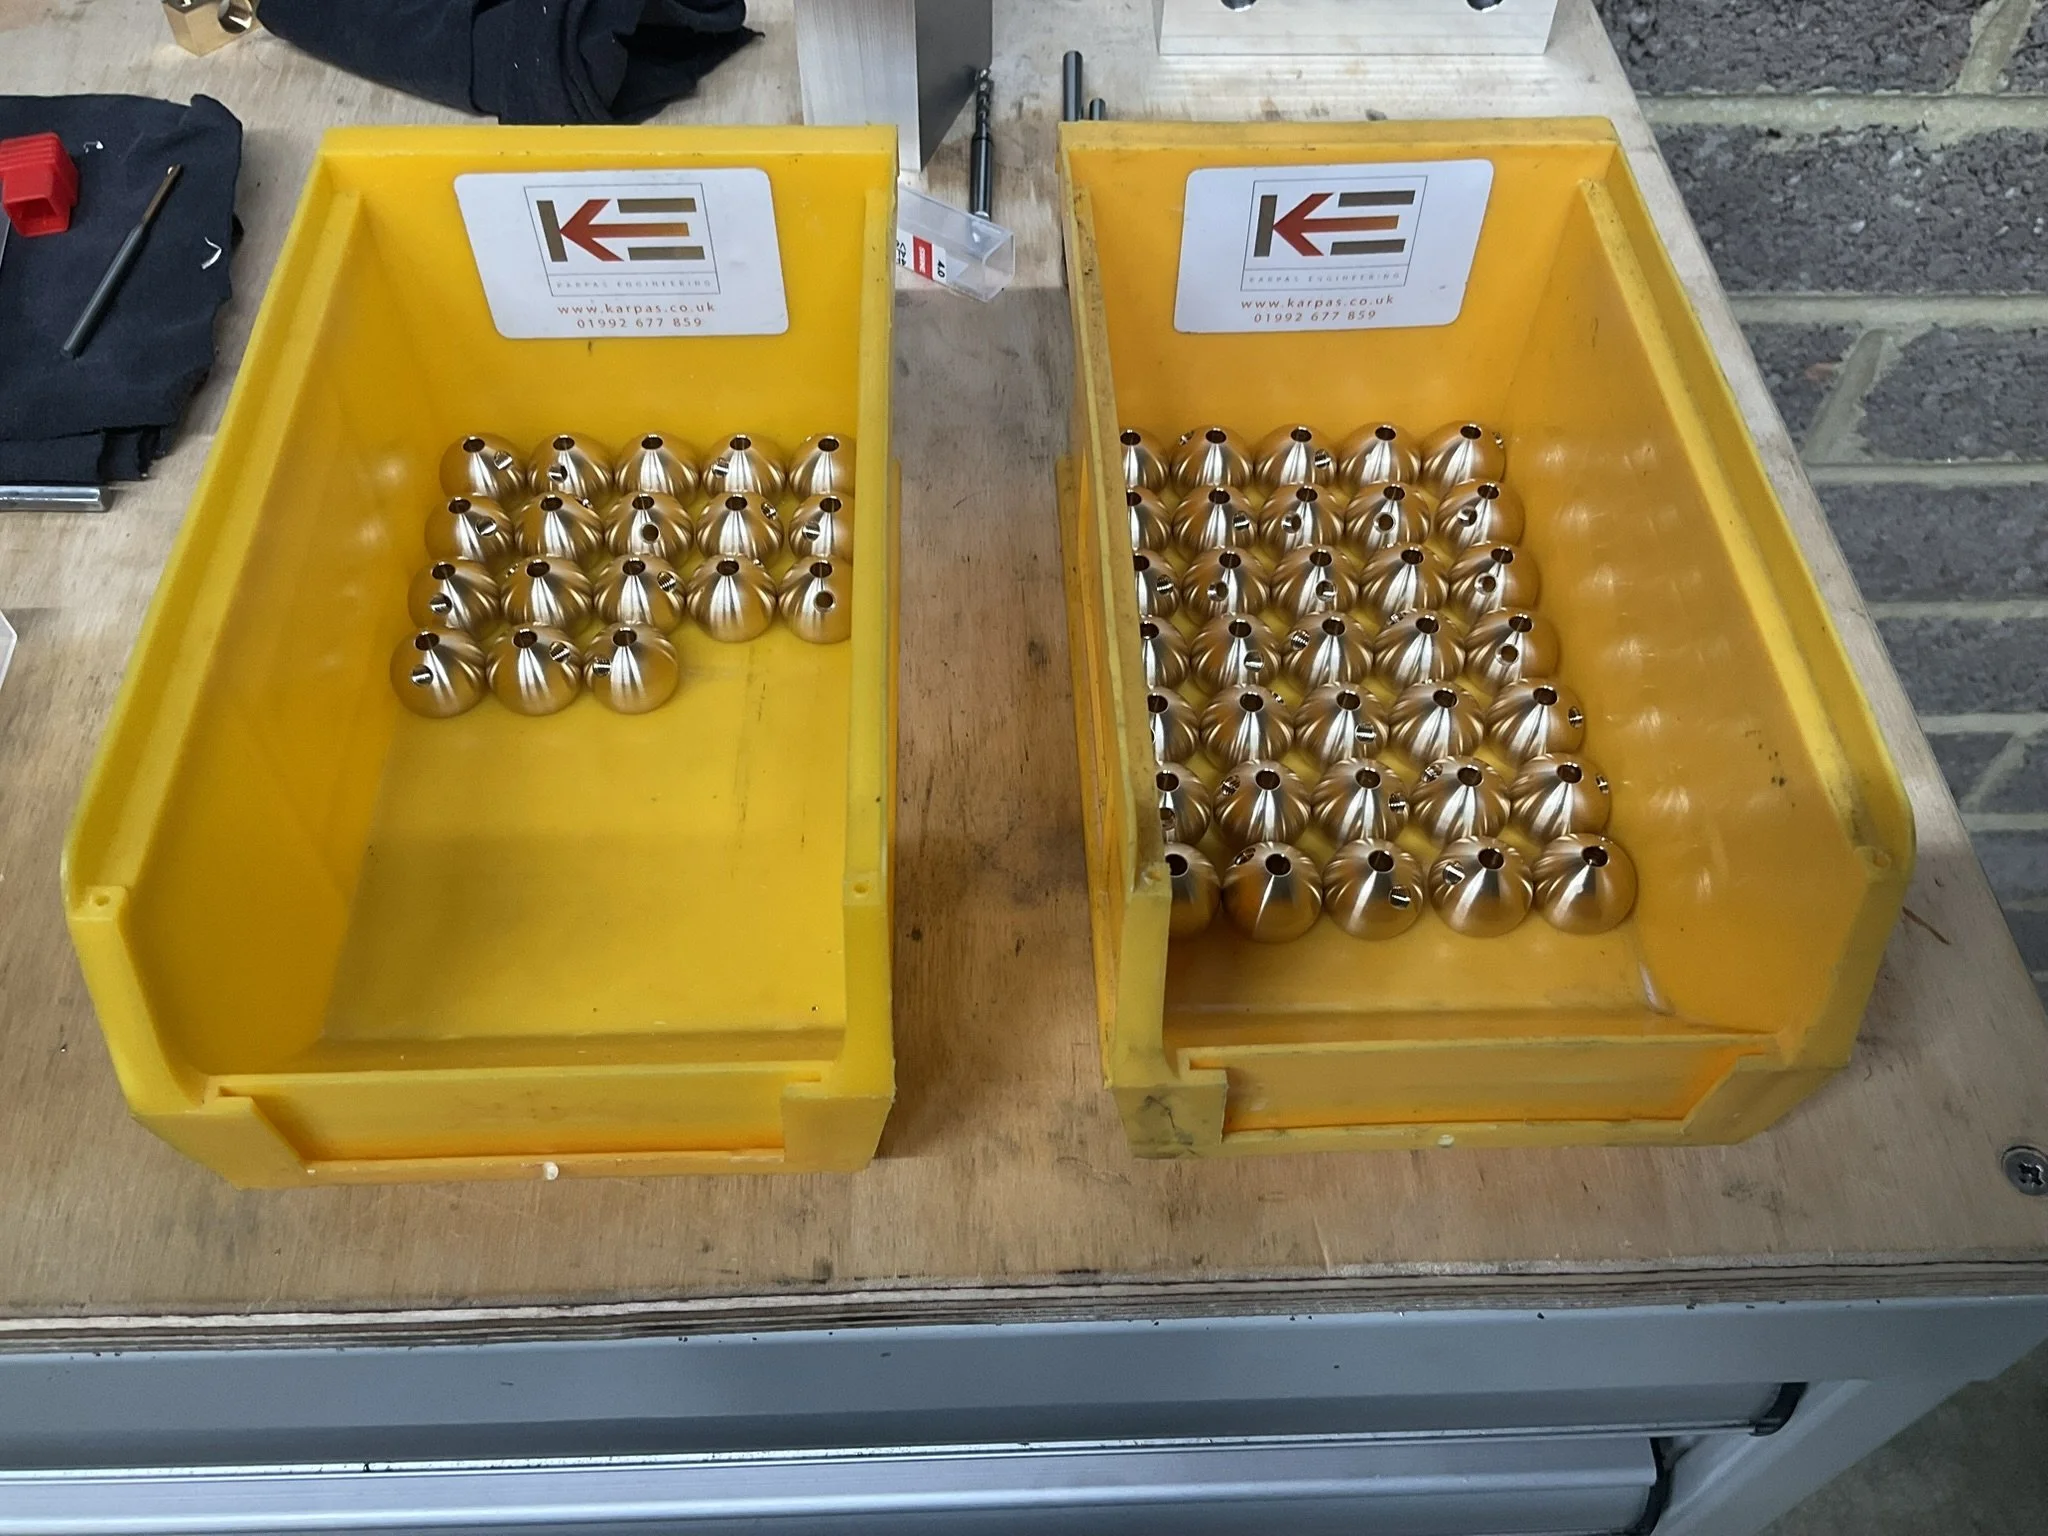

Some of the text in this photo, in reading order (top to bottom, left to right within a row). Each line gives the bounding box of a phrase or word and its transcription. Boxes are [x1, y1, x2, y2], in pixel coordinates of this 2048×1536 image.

[1241, 294, 1394, 309] www.karpas.co.uk
[557, 302, 715, 315] www.karpas.co.uk
[577, 317, 702, 329] 01992 677 859
[1254, 310, 1376, 323] 01992 677 859
